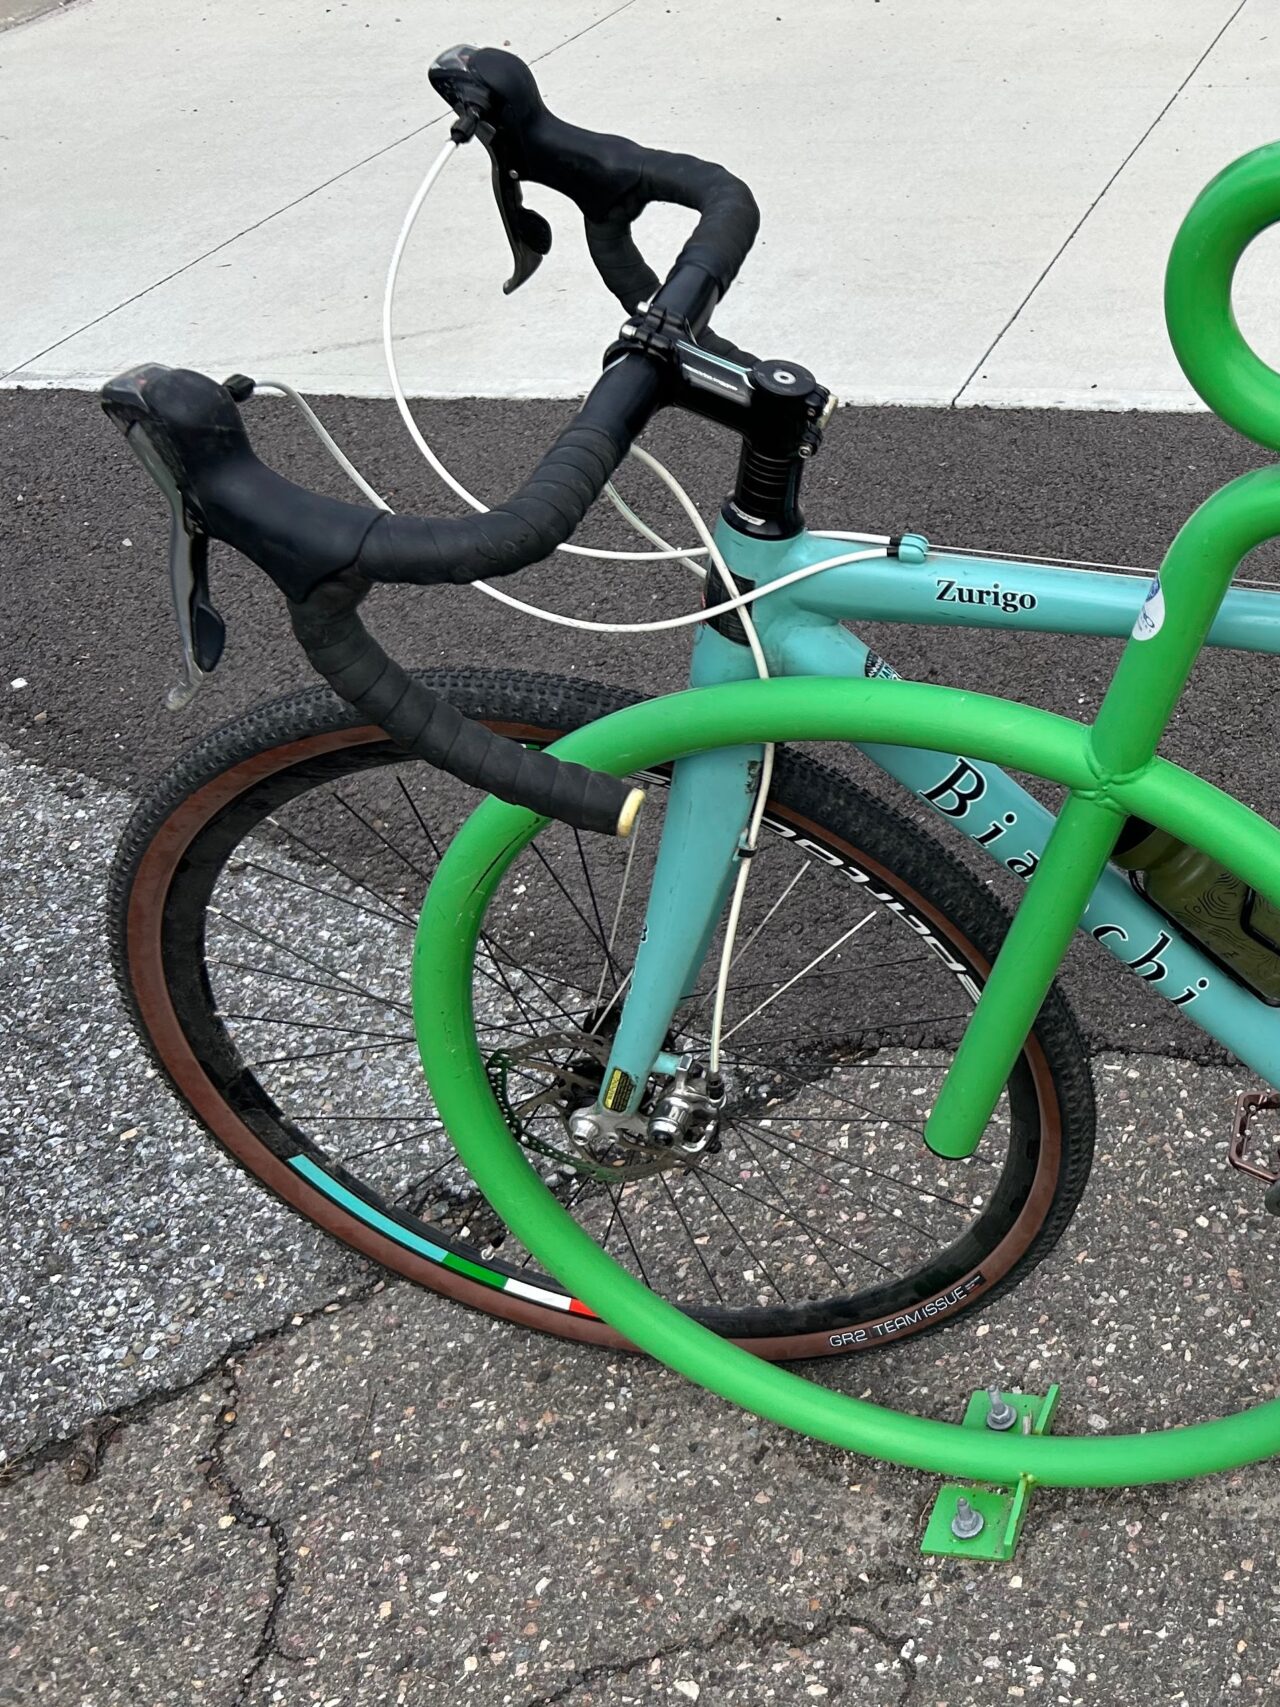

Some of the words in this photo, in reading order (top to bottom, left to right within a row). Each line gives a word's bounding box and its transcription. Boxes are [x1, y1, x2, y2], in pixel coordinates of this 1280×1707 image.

[935, 579, 1037, 613] Zurigo
[918, 756, 1210, 1009] Biachi
[829, 1330, 869, 1347] GR2
[874, 1312, 923, 1336] TEAM
[921, 1285, 968, 1318] ISSUE
